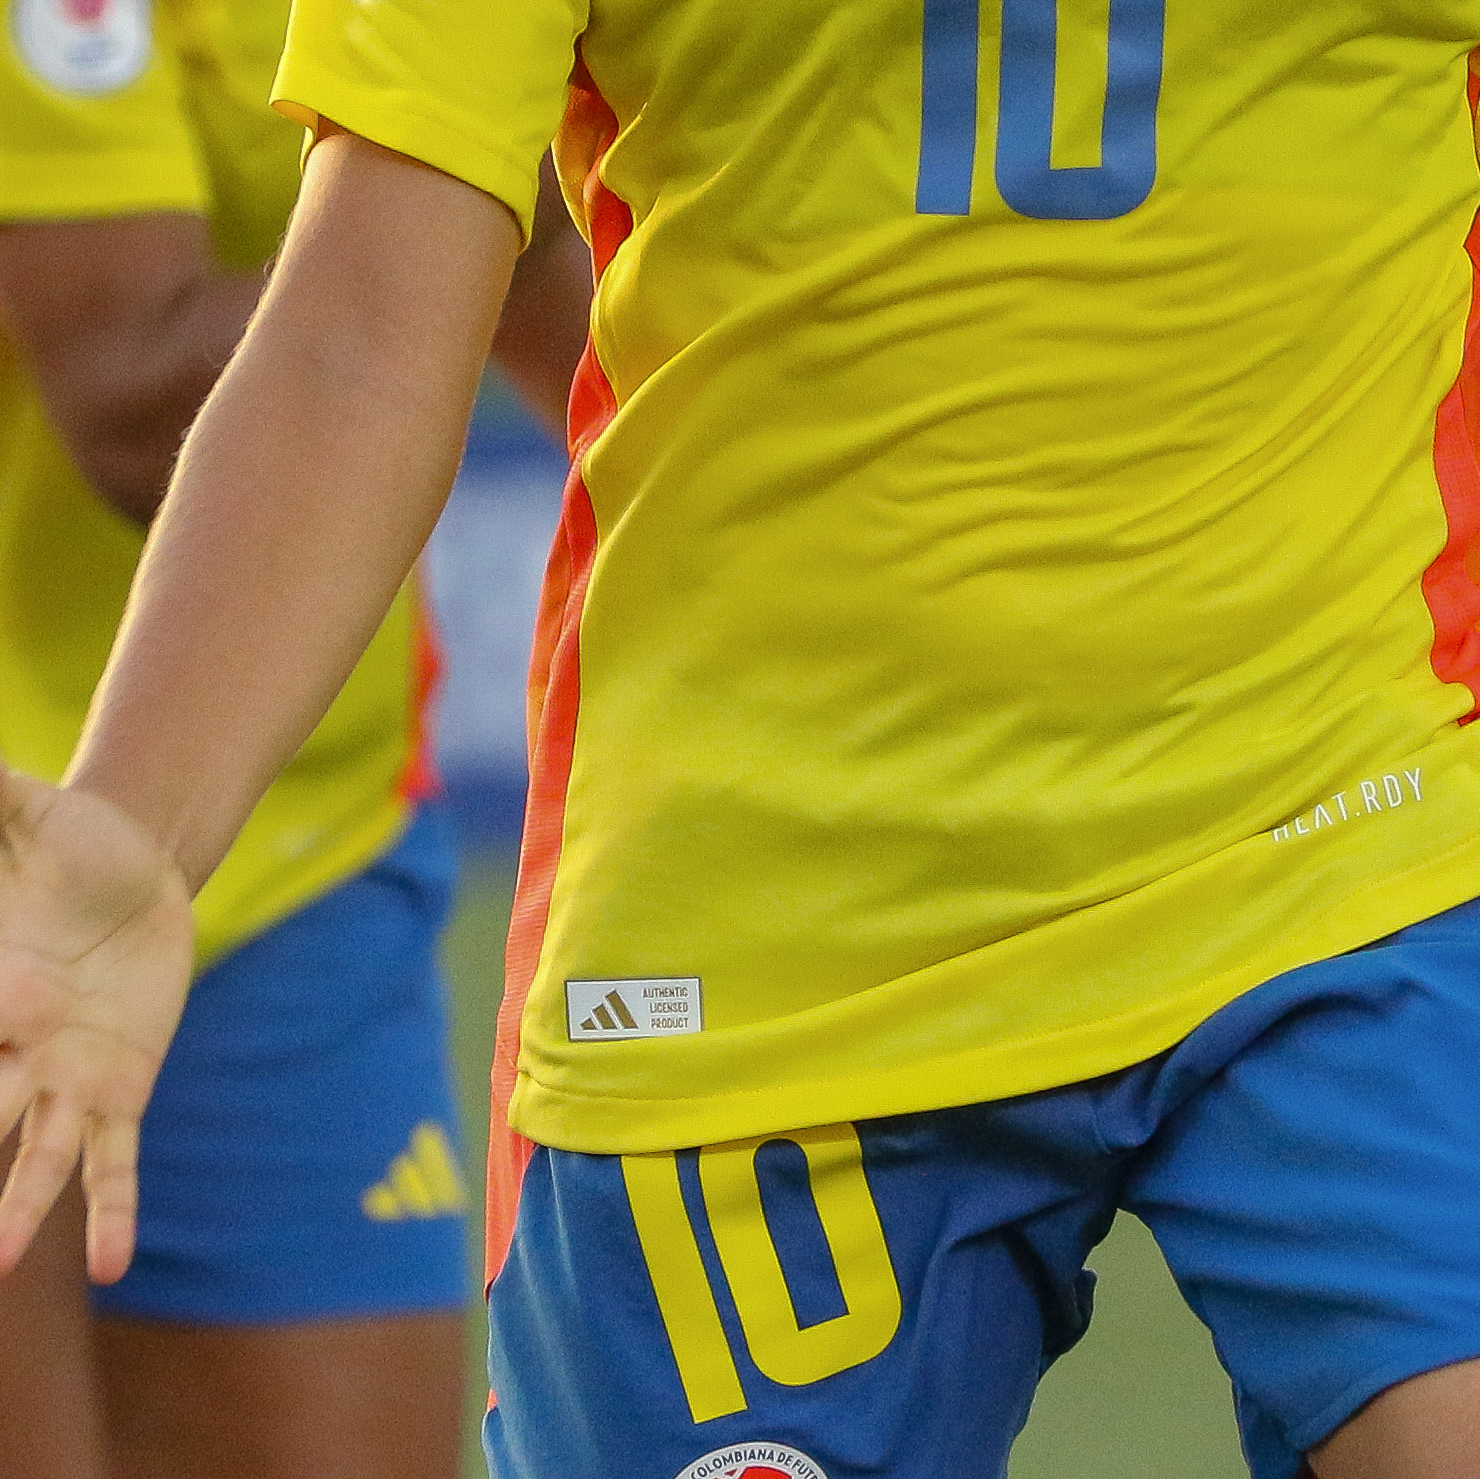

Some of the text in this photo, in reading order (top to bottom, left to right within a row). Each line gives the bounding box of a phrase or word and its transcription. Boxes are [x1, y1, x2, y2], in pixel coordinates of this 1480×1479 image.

[642, 986, 689, 998] AUTHENTIC
[649, 1001, 689, 1014] LICENSED
[650, 1017, 689, 1029] PRODUCT
[620, 1121, 903, 1424] 10
[691, 1449, 775, 1479] COLOMBIANA
[777, 1451, 794, 1467] DE
